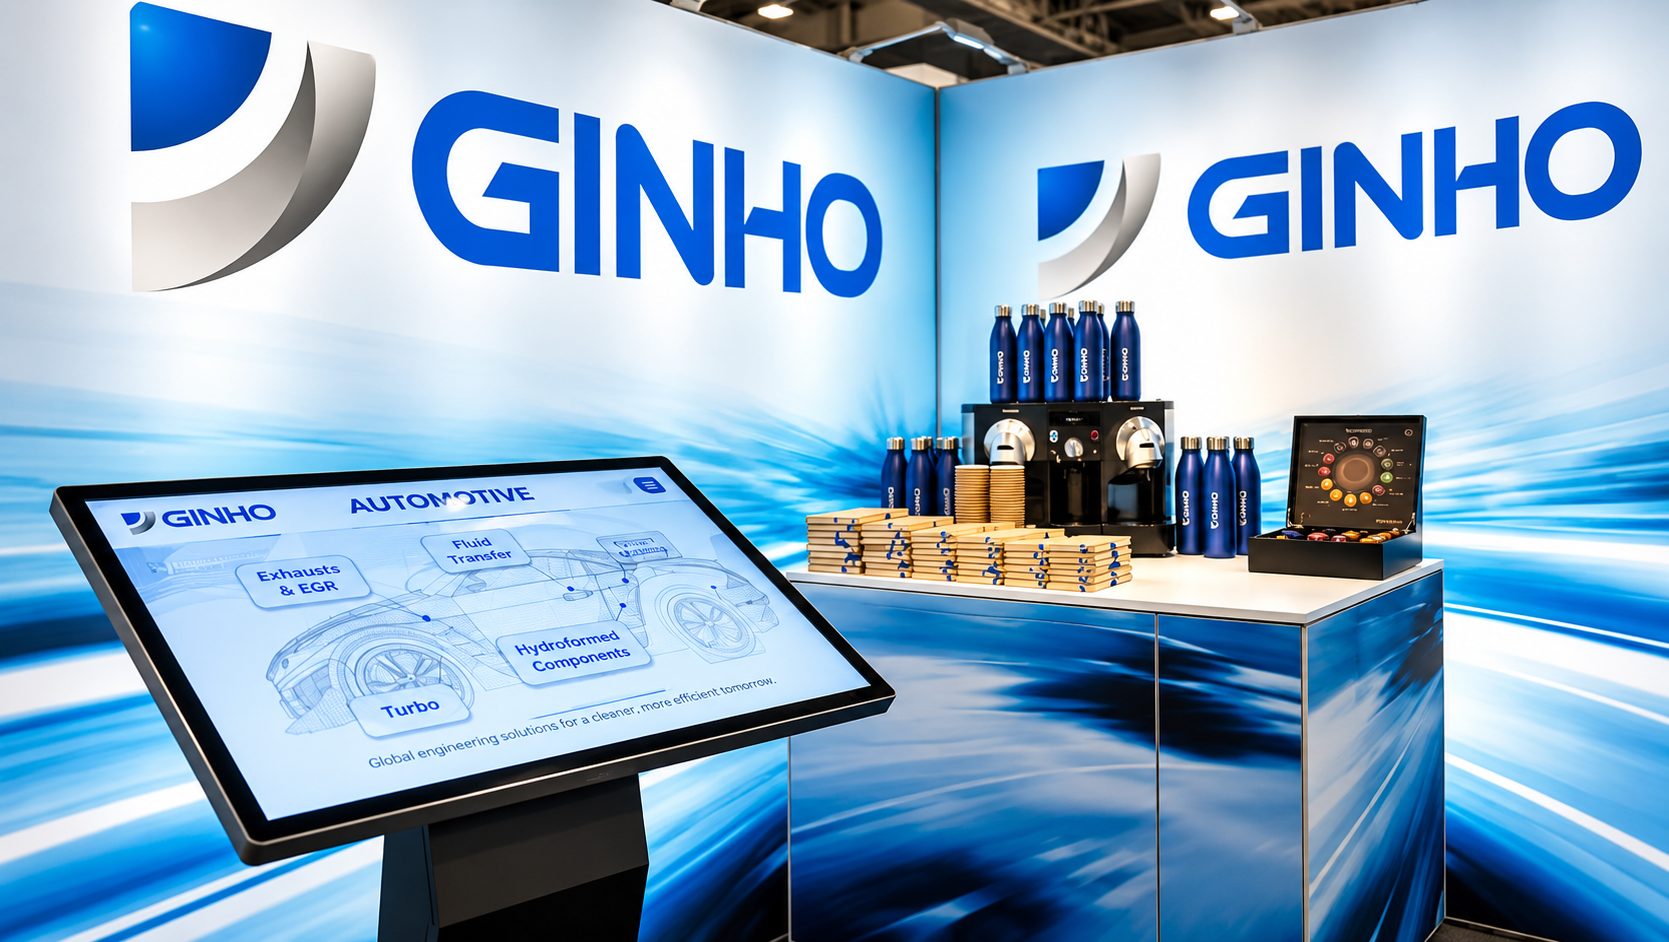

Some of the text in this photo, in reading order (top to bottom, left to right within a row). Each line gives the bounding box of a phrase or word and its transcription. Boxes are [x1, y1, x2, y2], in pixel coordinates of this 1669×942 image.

[1187, 101, 1643, 259] GINHO
[411, 89, 883, 298] GINHO
[350, 486, 536, 515] AUTOMOTIVE
[161, 504, 277, 528] GINHO
[451, 536, 493, 550] Fluid
[447, 549, 513, 566] Transfer
[256, 563, 341, 582] Exhausts
[279, 580, 339, 597] & EGR
[514, 629, 620, 657] Hydroformed
[532, 647, 632, 673] Components
[380, 700, 441, 719] Turbo
[368, 676, 778, 769] Global engineering solutions for a cleaner, more efficient tomorrow.
